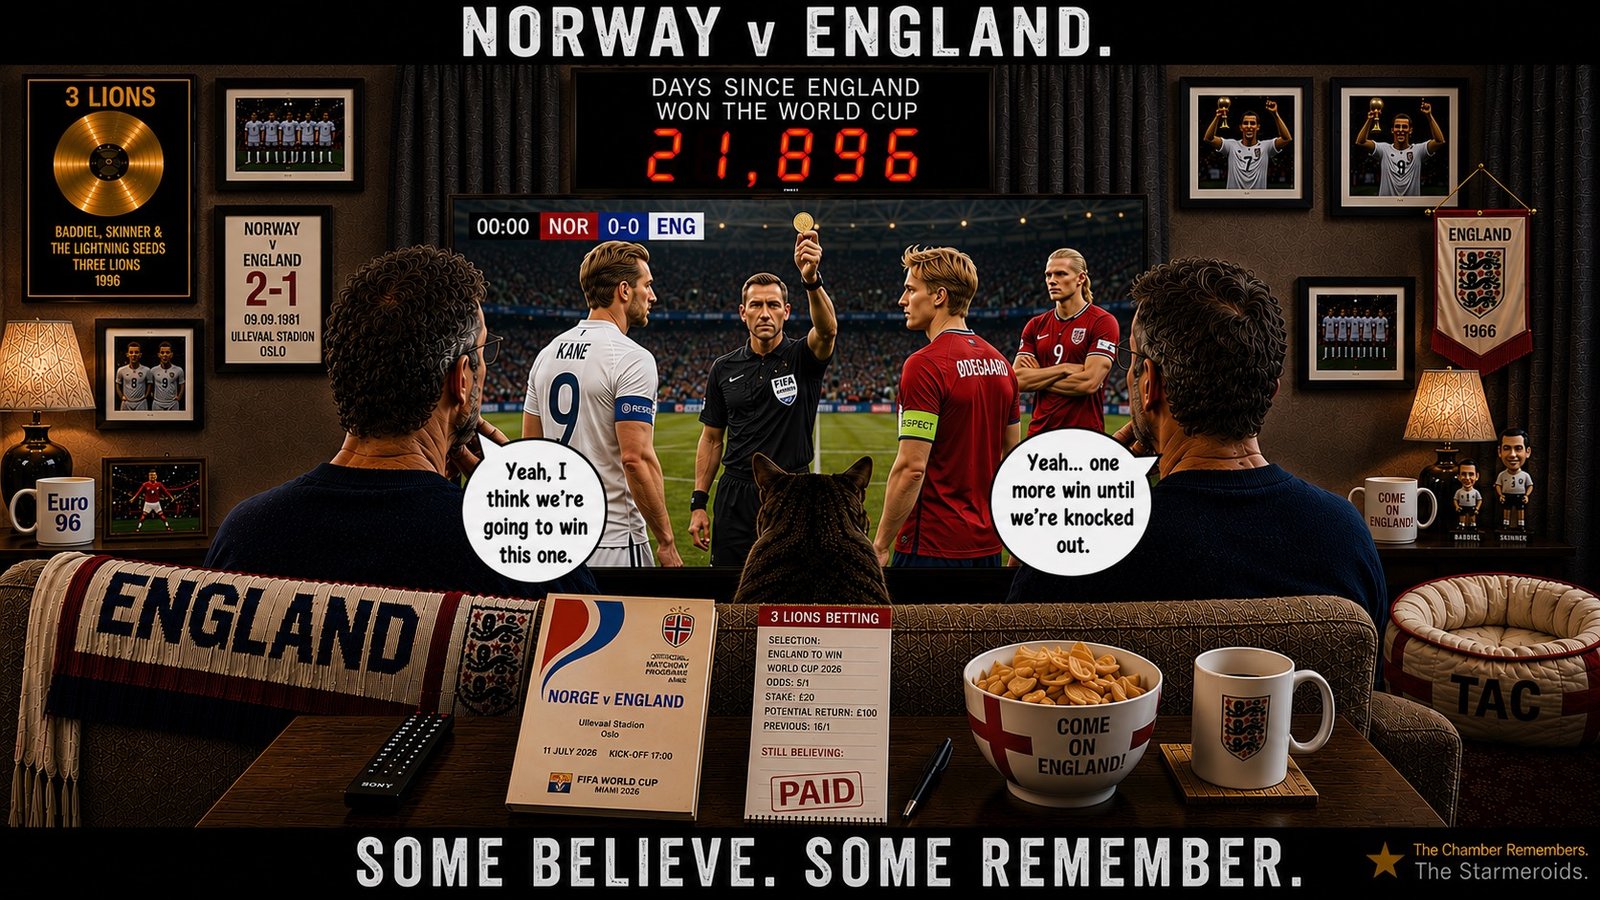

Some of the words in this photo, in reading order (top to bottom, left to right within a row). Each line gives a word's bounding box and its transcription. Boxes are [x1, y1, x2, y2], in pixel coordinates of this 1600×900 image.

[652, 77, 711, 97] DAYS
[725, 77, 795, 97] SINCE
[808, 77, 920, 97] ENGLAND
[65, 87, 79, 107] 3
[89, 87, 156, 108] LIONS
[657, 102, 711, 121] WON
[722, 102, 768, 121] THE
[779, 102, 860, 121] WORLD
[871, 102, 918, 121] CUP
[646, 128, 920, 187] 21,896
[55, 226, 102, 239] BADDIEL,
[105, 226, 151, 238] SKINNER
[153, 226, 163, 238] &
[244, 222, 301, 236] NORWAY
[476, 217, 529, 235] 00:00
[549, 217, 588, 235] NOR
[608, 217, 639, 235] 0-0
[656, 217, 696, 235] ENG
[1448, 227, 1512, 242] ENGLAND
[51, 242, 72, 255] THE
[73, 242, 131, 255] LIGHTNING
[133, 242, 166, 255] SEEDS
[269, 240, 277, 250] V
[73, 258, 107, 271] THREE
[109, 258, 141, 271] LIONS
[243, 254, 302, 267] ENGLAND
[95, 275, 120, 287] 1996
[245, 271, 297, 307] 2-1
[244, 314, 300, 326] 09.09.1981
[231, 331, 274, 342] ULLEVAAL
[276, 331, 315, 342] STADION
[1462, 324, 1496, 338] 1966
[260, 346, 286, 357] OSLO
[556, 342, 591, 360] KANE
[1053, 344, 1064, 364] 9
[956, 358, 1009, 379] ØDEGAARD
[549, 372, 580, 446] 9
[901, 419, 934, 430] ESPECT
[47, 492, 89, 512] Euro
[1378, 492, 1406, 504] COME
[1386, 505, 1399, 515] ON
[54, 514, 81, 532] 96
[1370, 516, 1414, 528] ENGLAND!
[96, 571, 420, 675] ENGLAND
[771, 611, 779, 622] 3
[784, 611, 821, 623] LIONS
[826, 612, 880, 625] BETTING
[768, 636, 821, 645] SELECTION:
[768, 650, 809, 659] ENGLAND
[811, 650, 823, 659] TO
[825, 650, 842, 659] WIN
[767, 664, 798, 673] WORLD
[801, 664, 818, 673] CUP
[821, 665, 842, 673] 2026
[766, 678, 794, 687] ODDS:
[548, 689, 599, 705] NORGE
[603, 695, 610, 705] v
[614, 692, 684, 709] ENGLAND
[765, 692, 796, 702] STAKE:
[799, 693, 815, 702] £20
[1448, 674, 1542, 721] TAC
[764, 707, 812, 716] POTENTIAL
[815, 707, 853, 717] RETURN:
[856, 708, 877, 717] £100
[579, 719, 611, 728] Ullevaal
[613, 720, 645, 729] Stadion
[763, 722, 810, 731] PREVIOUS:
[814, 722, 830, 731] 16/1
[1056, 716, 1111, 737] COME
[601, 730, 619, 738] Oslo
[543, 746, 550, 754] 11
[552, 747, 575, 755] JULY
[576, 748, 597, 757] 2026
[609, 750, 649, 759] KICK-OFF
[651, 751, 673, 760] 17:00
[761, 748, 787, 757] STILL
[791, 748, 844, 758] BELIEVING:
[1069, 738, 1095, 756] ON
[1038, 753, 1126, 777] ENGLAND!
[577, 775, 598, 784] FIFA
[601, 776, 636, 785] WORLD
[638, 778, 658, 786] CUP
[595, 786, 619, 794] MIAMI
[620, 787, 640, 795] 2026
[779, 778, 855, 806] PAID
